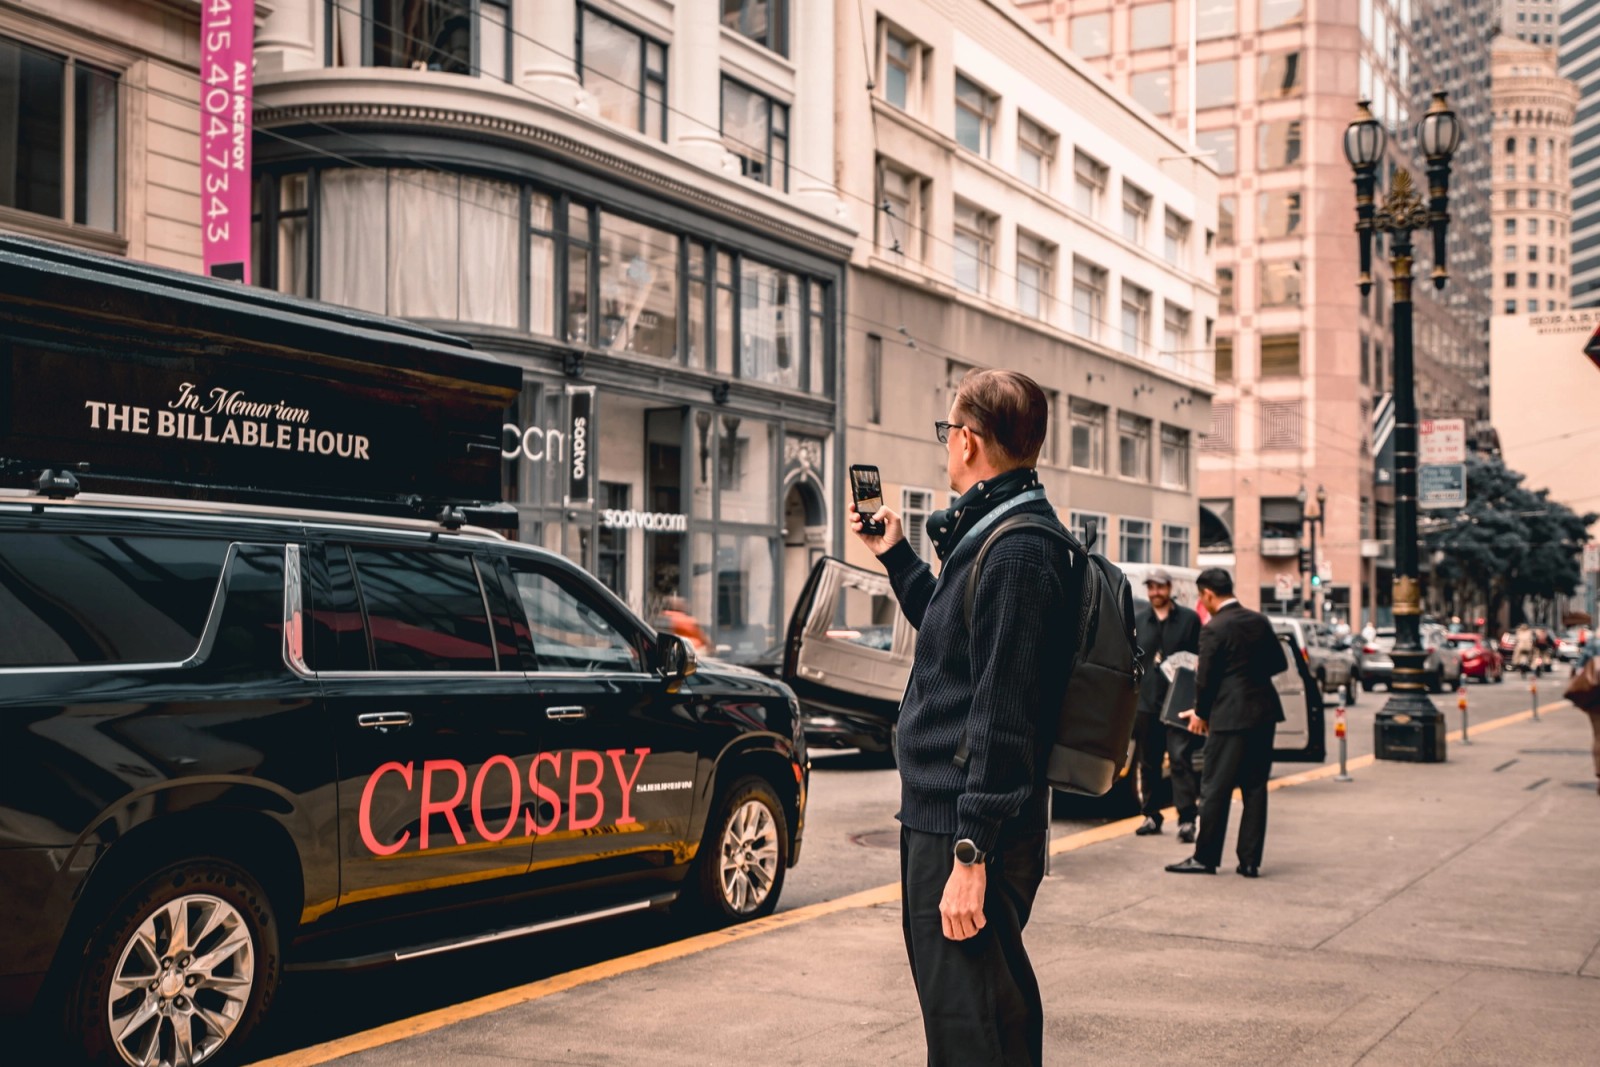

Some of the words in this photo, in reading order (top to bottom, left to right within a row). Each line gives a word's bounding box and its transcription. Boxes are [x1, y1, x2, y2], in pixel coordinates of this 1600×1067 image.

[233, 61, 247, 91] ALI
[206, 0, 231, 243] 415.404.7343
[85, 401, 150, 433] THE
[157, 410, 292, 450] BILLABLE
[297, 427, 370, 460] HOUR
[168, 382, 200, 409] In
[200, 388, 310, 424] Memoriam
[573, 417, 586, 479] saatva
[603, 508, 688, 532] saatva.com
[358, 747, 651, 857] CROSBY
